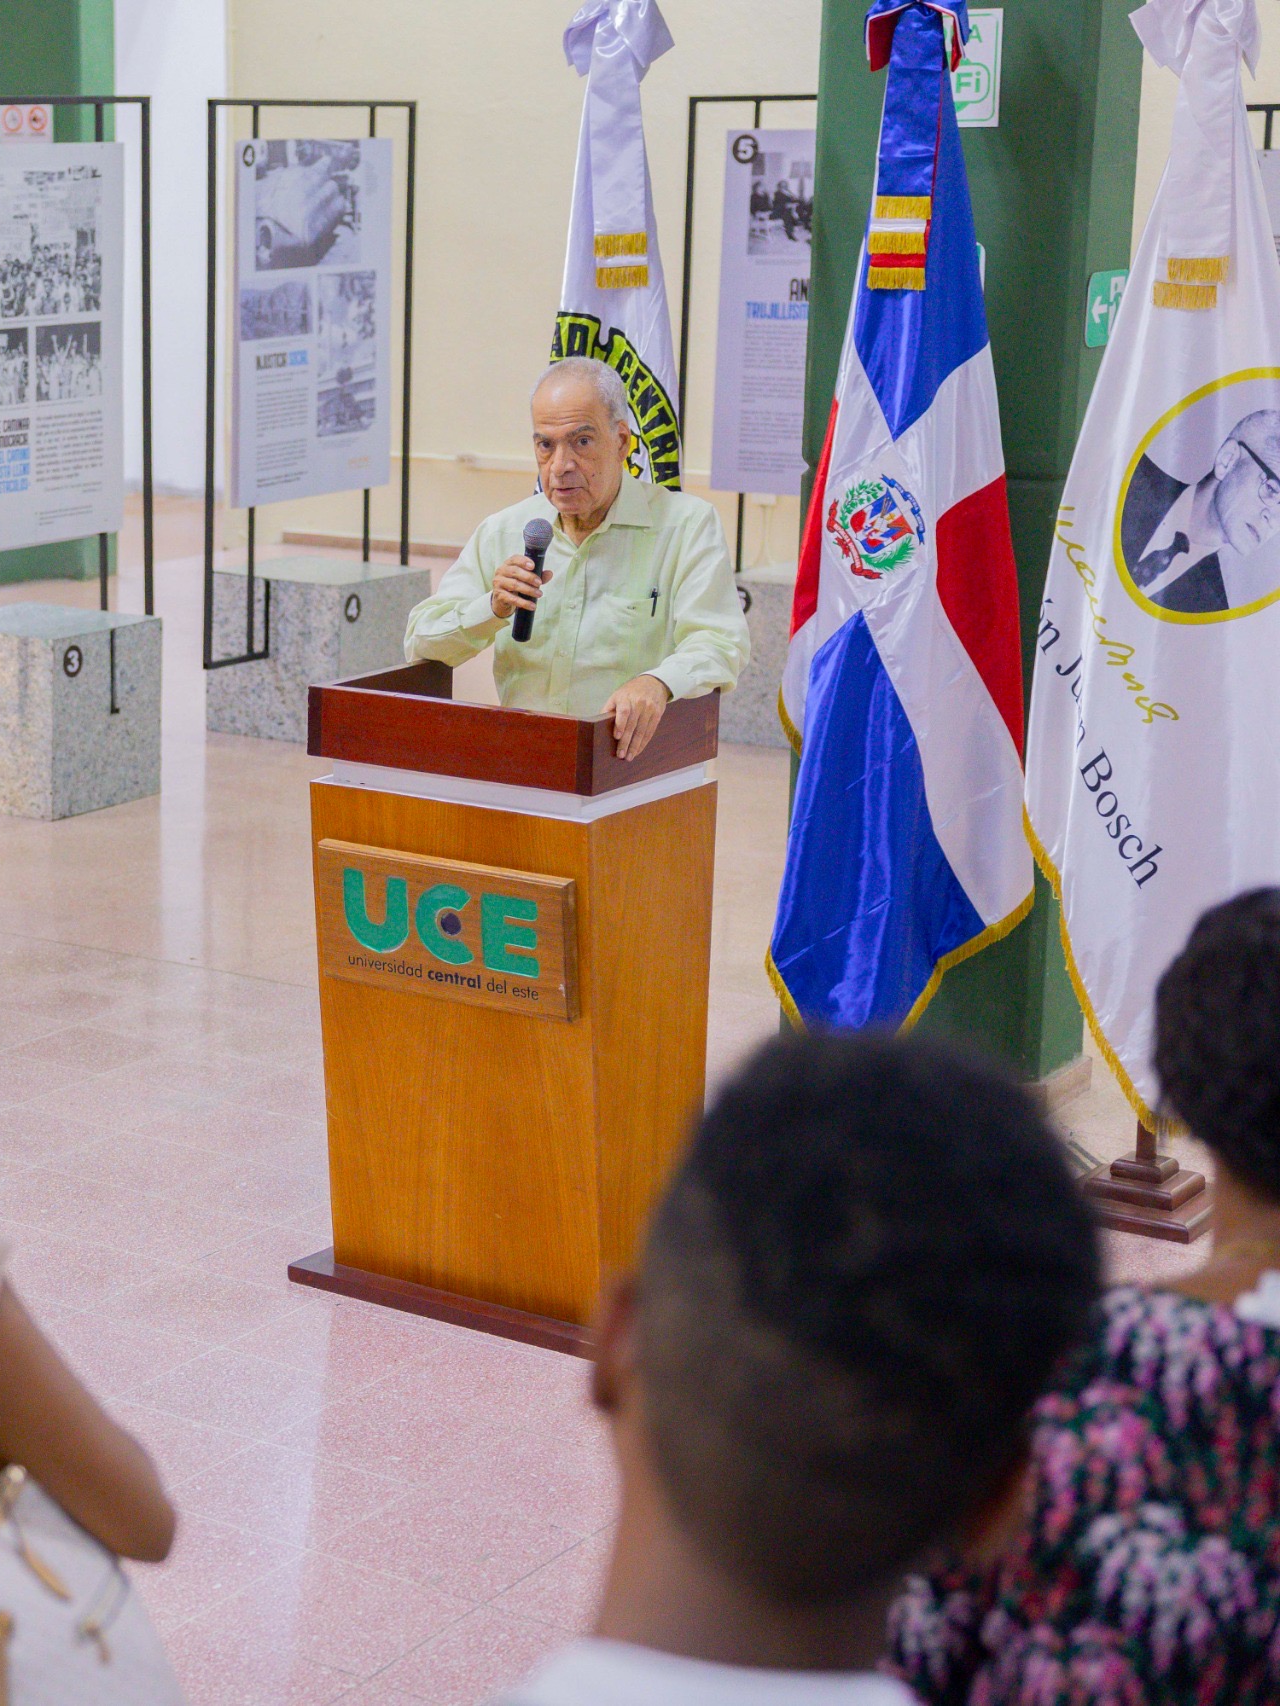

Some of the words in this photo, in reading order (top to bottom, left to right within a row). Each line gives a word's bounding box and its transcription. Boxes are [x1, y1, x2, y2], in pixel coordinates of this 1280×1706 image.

[789, 278, 808, 301] AN
[746, 301, 809, 320] TRUJILLISM
[615, 350, 680, 486] CENTRA
[347, 596, 358, 618] 4
[68, 649, 80, 674] 3
[1079, 746, 1163, 889] Bosch
[343, 867, 540, 979] UCE
[347, 953, 423, 979] universidad
[427, 968, 481, 990] central
[486, 976, 507, 995] del
[512, 985, 539, 1001] este
